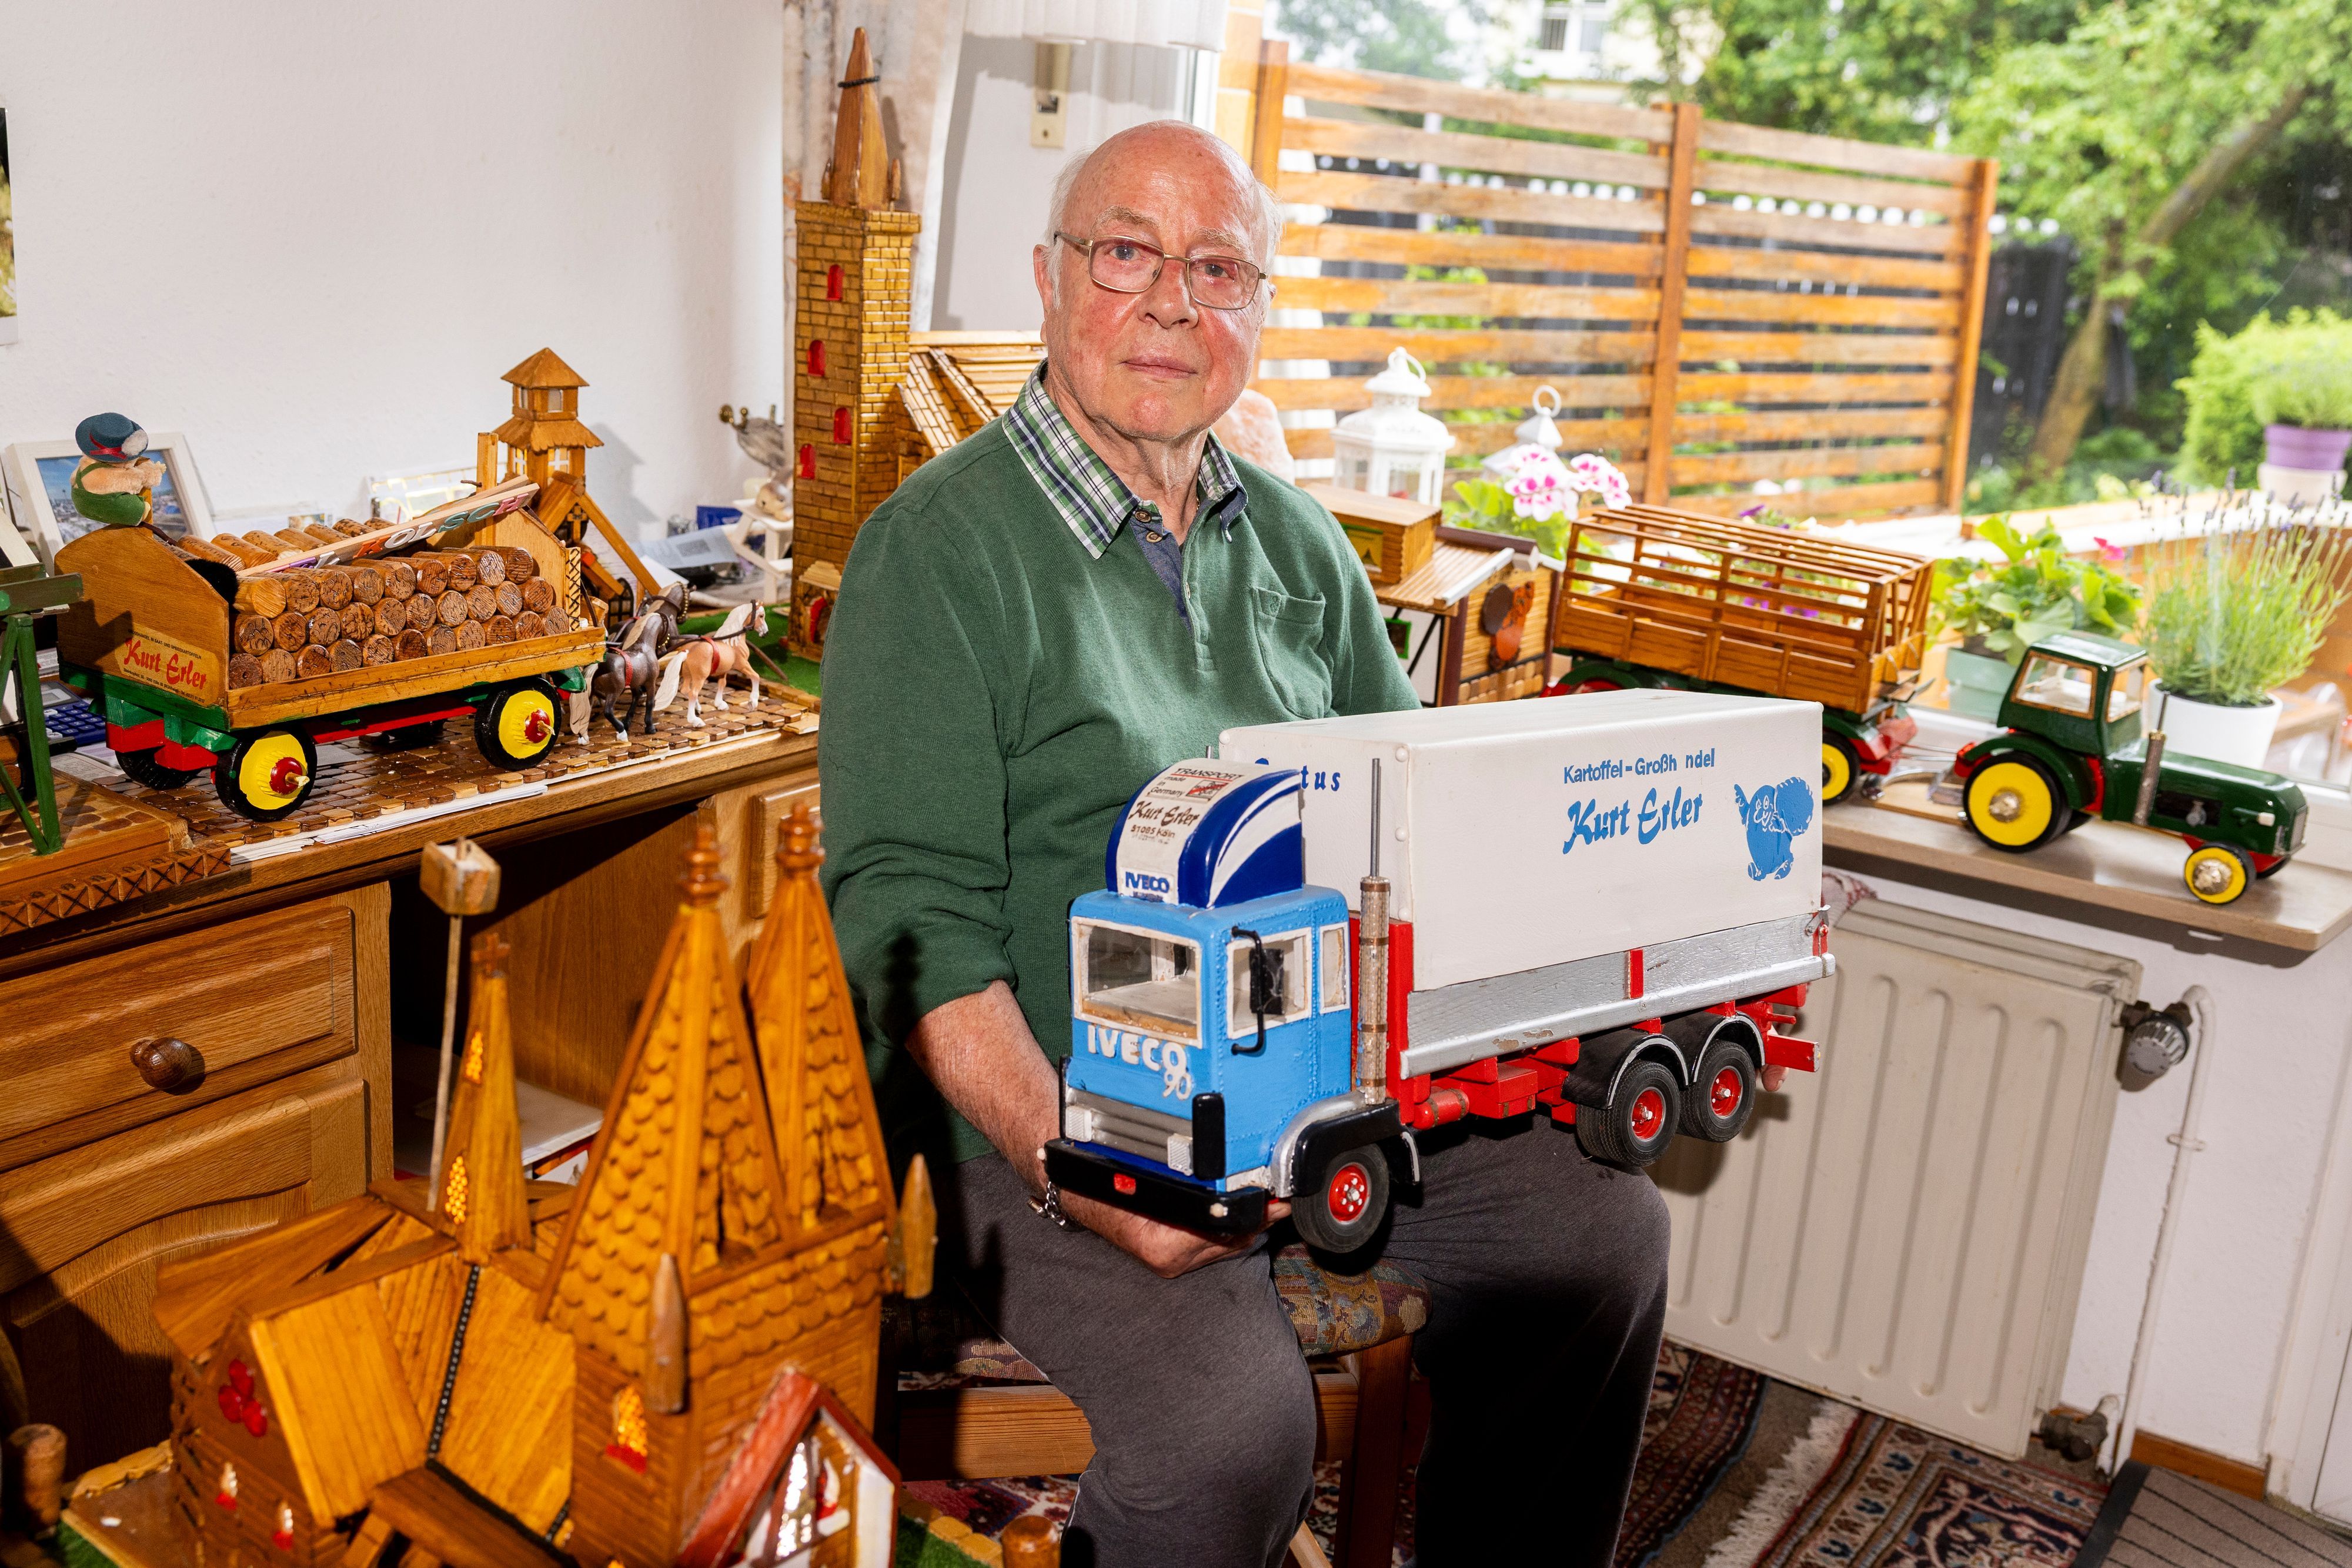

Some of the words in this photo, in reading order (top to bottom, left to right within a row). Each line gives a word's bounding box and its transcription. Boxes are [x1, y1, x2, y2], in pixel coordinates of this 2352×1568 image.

[123, 637, 161, 673] Kurt
[166, 653, 206, 690] Erler
[1174, 768, 1244, 780] TRANSPORT
[1150, 787, 1187, 798] Germany
[1128, 800, 1164, 821] Kurt
[1161, 805, 1201, 827] Erler
[1562, 798, 1630, 855] Kurt
[1637, 786, 1703, 845] Erler
[1156, 827, 1175, 838] Köln
[1125, 871, 1170, 894] IVECO
[1088, 1024, 1187, 1072] IVECO
[1162, 1069, 1192, 1101] 90
